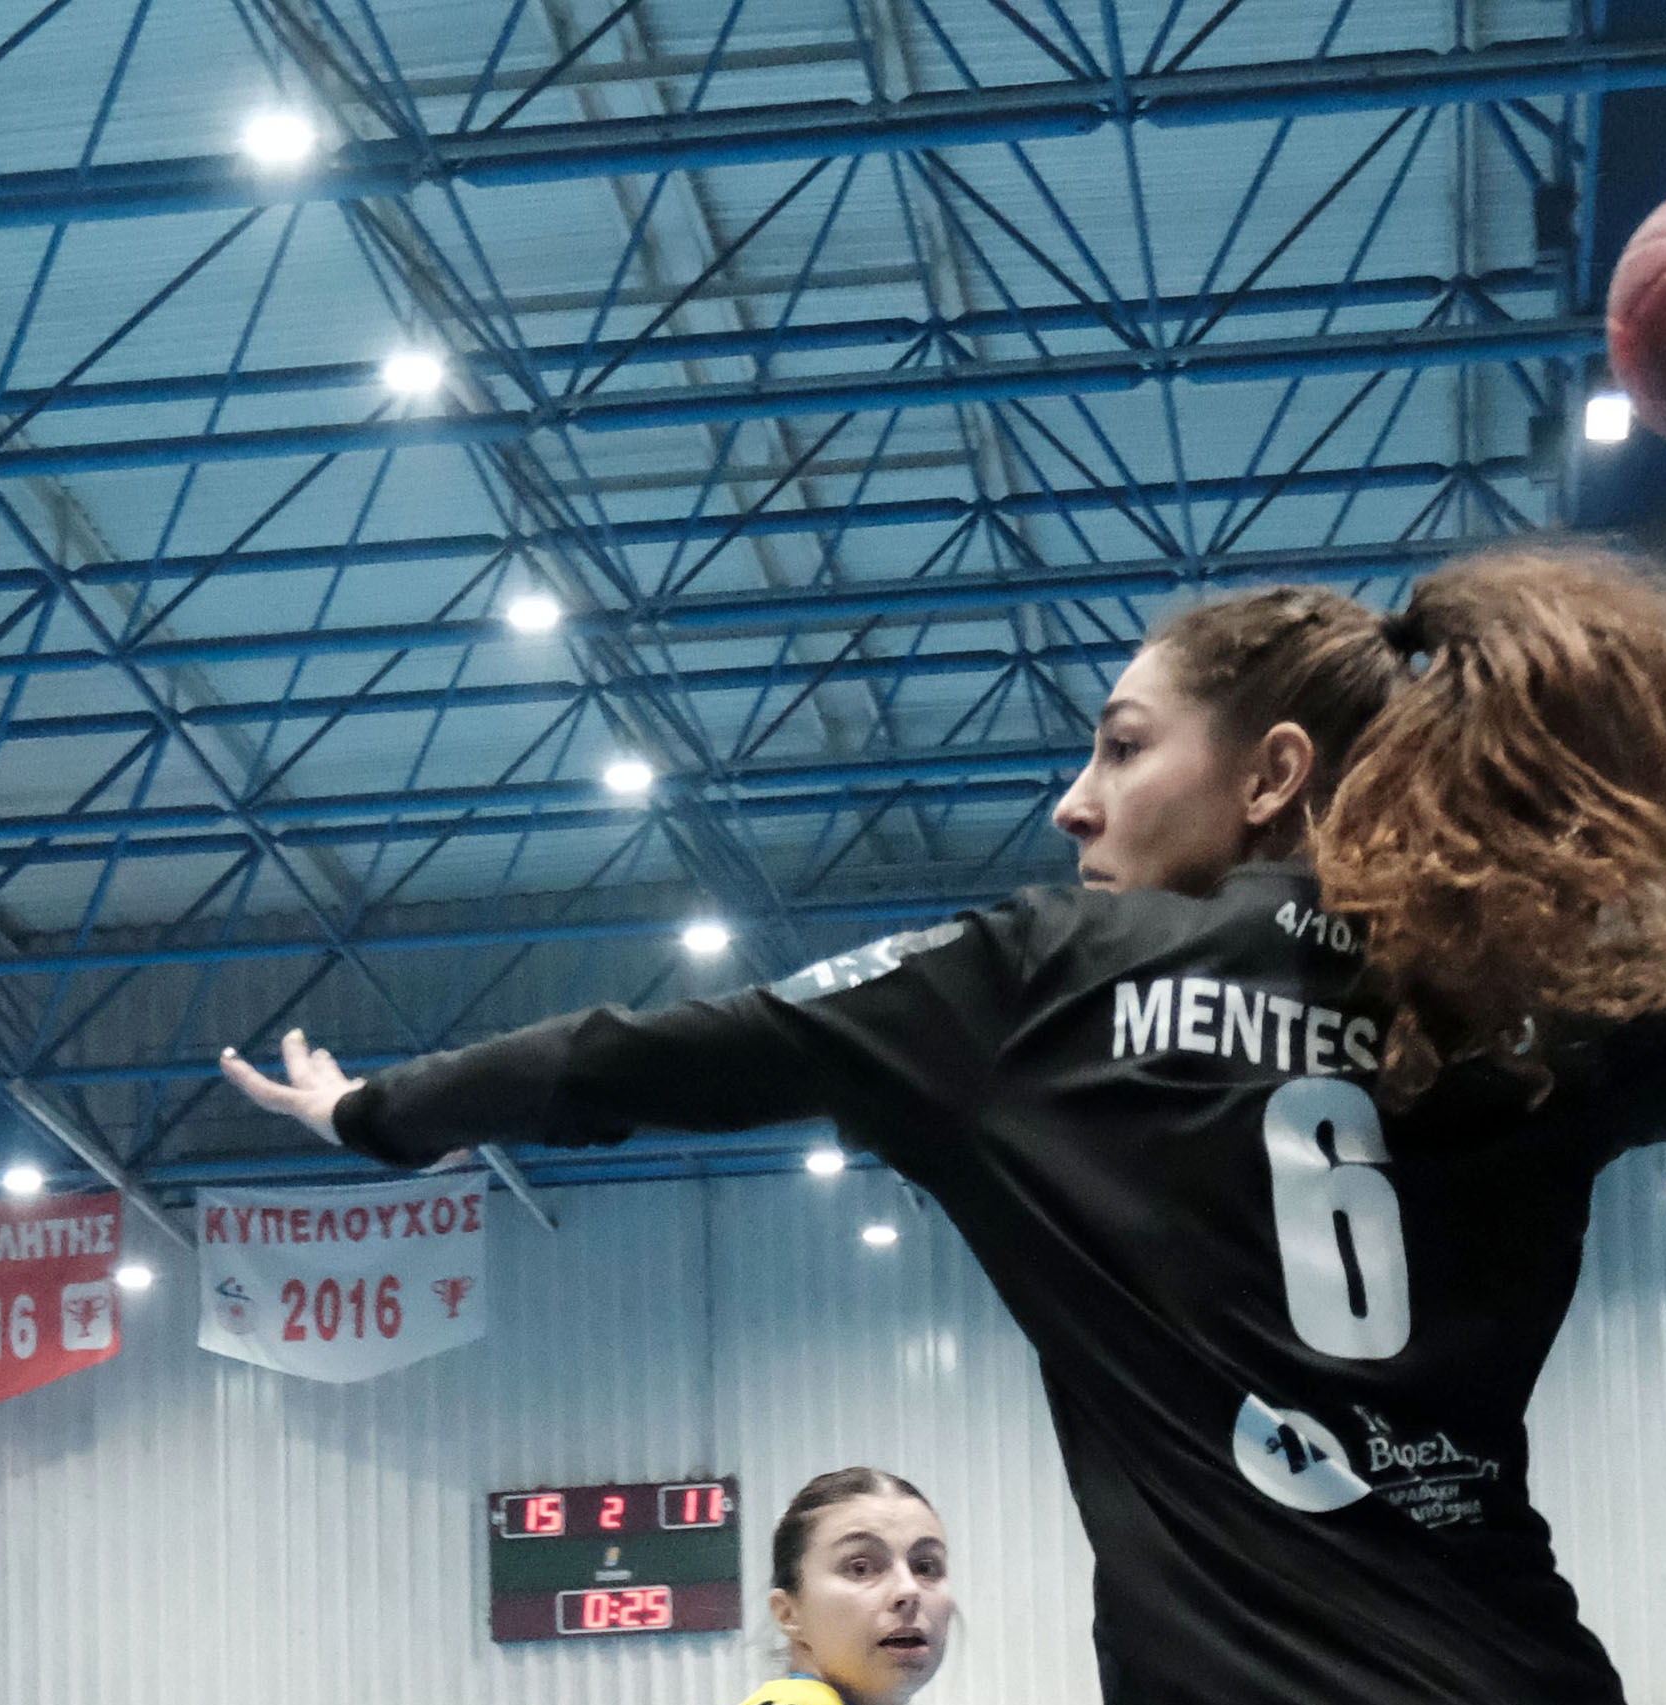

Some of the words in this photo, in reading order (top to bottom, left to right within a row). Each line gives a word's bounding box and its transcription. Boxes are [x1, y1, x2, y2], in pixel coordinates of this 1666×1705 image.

[1111, 975, 1380, 1076] MENTES
[205, 1193, 483, 1246] ΚΥΠΕΛΟΥΧΟΣ
[1263, 1076, 1412, 1362] 6
[281, 1274, 403, 1342] 2016
[524, 1493, 562, 1534] 15
[599, 1496, 625, 1530] 2
[684, 1487, 723, 1524] 11
[583, 1590, 670, 1630] 0:25
